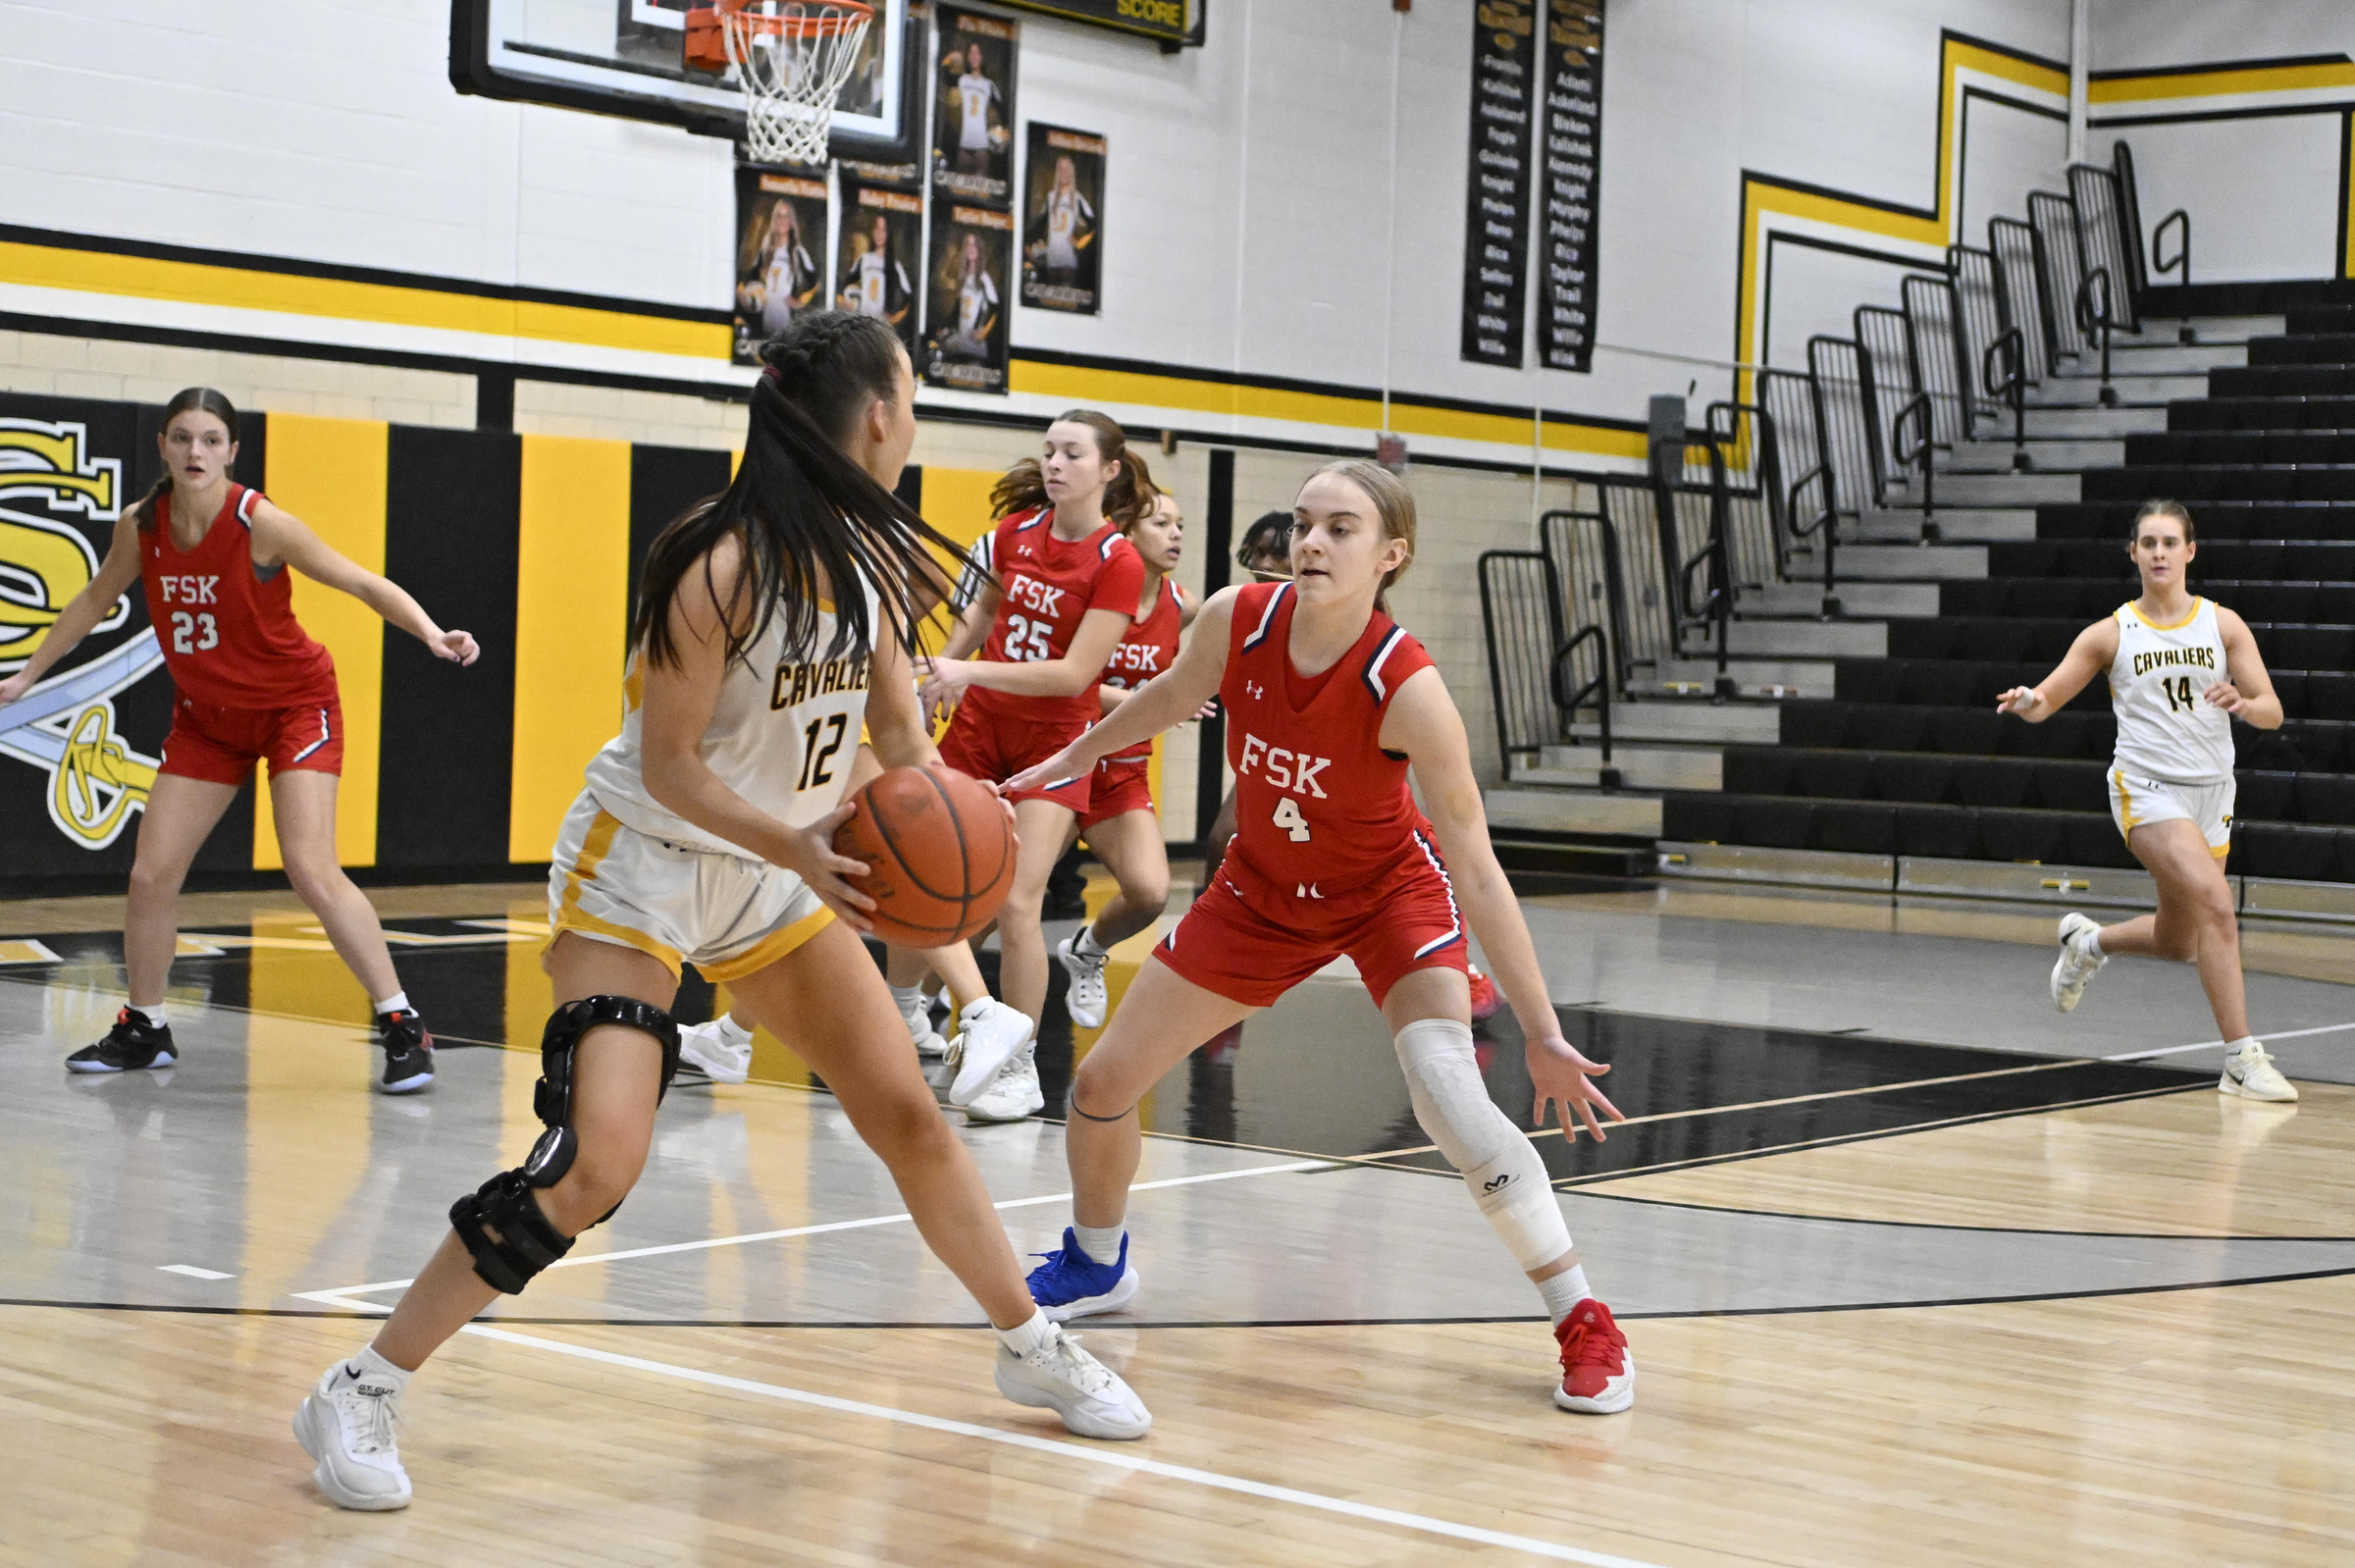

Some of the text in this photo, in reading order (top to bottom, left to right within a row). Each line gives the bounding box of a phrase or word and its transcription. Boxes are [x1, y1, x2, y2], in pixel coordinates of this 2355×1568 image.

[1117, 0, 1180, 27] SCORE
[160, 575, 220, 603] FSK
[1007, 574, 1066, 618] FSK
[171, 610, 219, 654] 23
[1004, 613, 1054, 662] 25
[1108, 643, 1161, 672] FSK
[2133, 647, 2215, 677] CAVALIERS
[2162, 676, 2194, 712] 14
[796, 710, 848, 792] 12
[1239, 732, 1332, 799] FSK
[1272, 796, 1311, 842] 4
[374, 1385, 395, 1397] CUT
